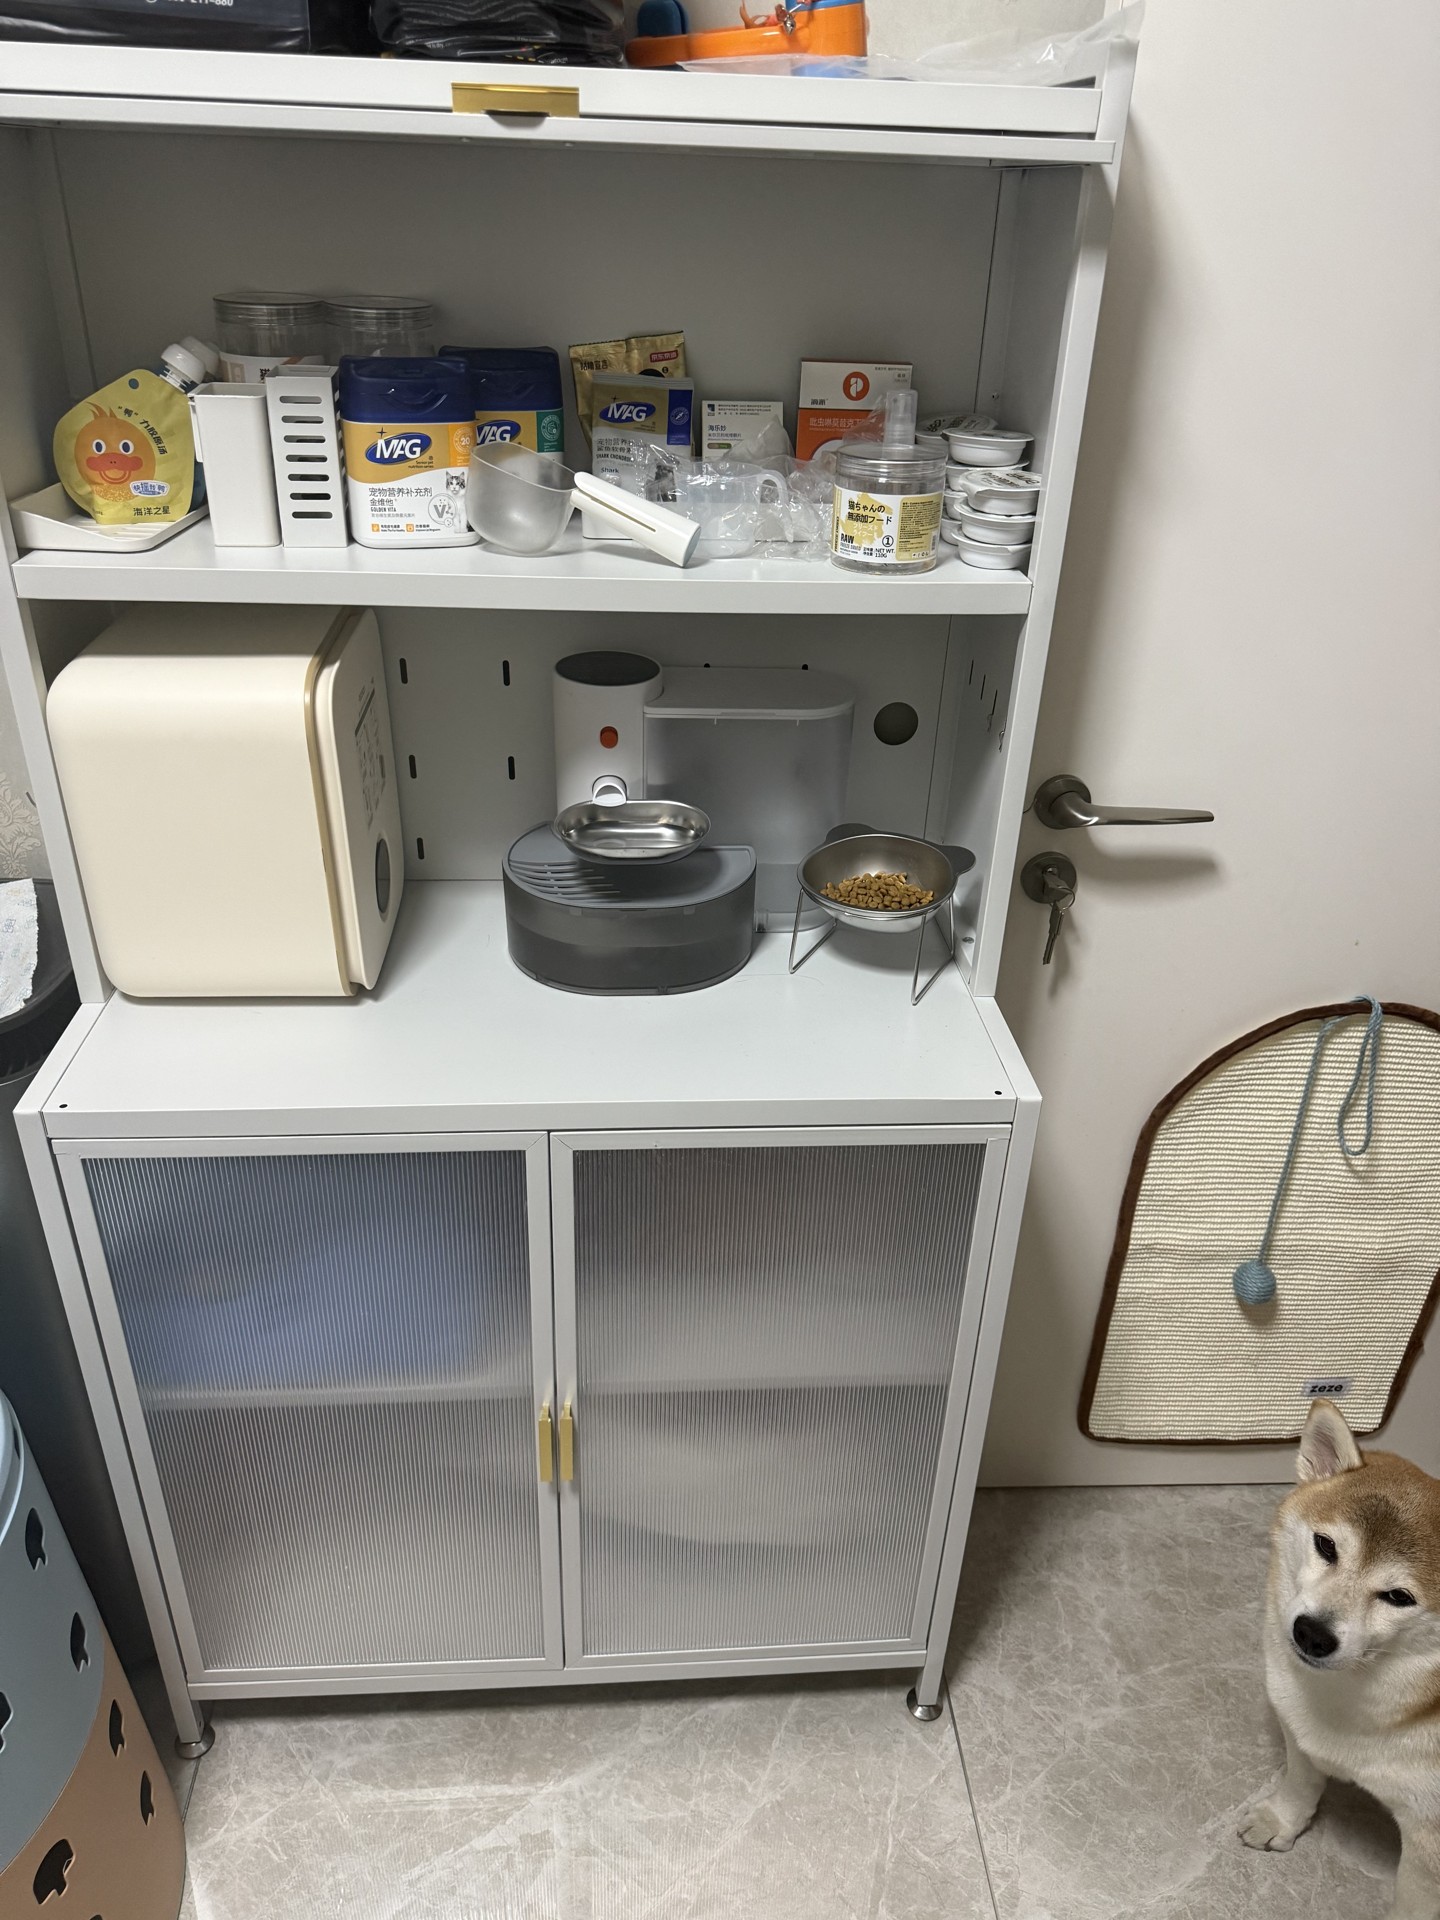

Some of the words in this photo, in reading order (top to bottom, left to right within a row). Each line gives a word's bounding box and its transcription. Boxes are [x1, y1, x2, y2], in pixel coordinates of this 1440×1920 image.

[607, 403, 647, 422] MAG
[375, 438, 422, 459] MAG
[369, 487, 433, 498] 宠物营养补充剂
[370, 498, 394, 507] 金维他
[847, 500, 886, 513] 猫ちゃんの
[133, 505, 171, 517] 海洋之星
[847, 512, 893, 525] 無添加フード
[840, 533, 855, 544] RAW
[1310, 1384, 1343, 1393] zeze
